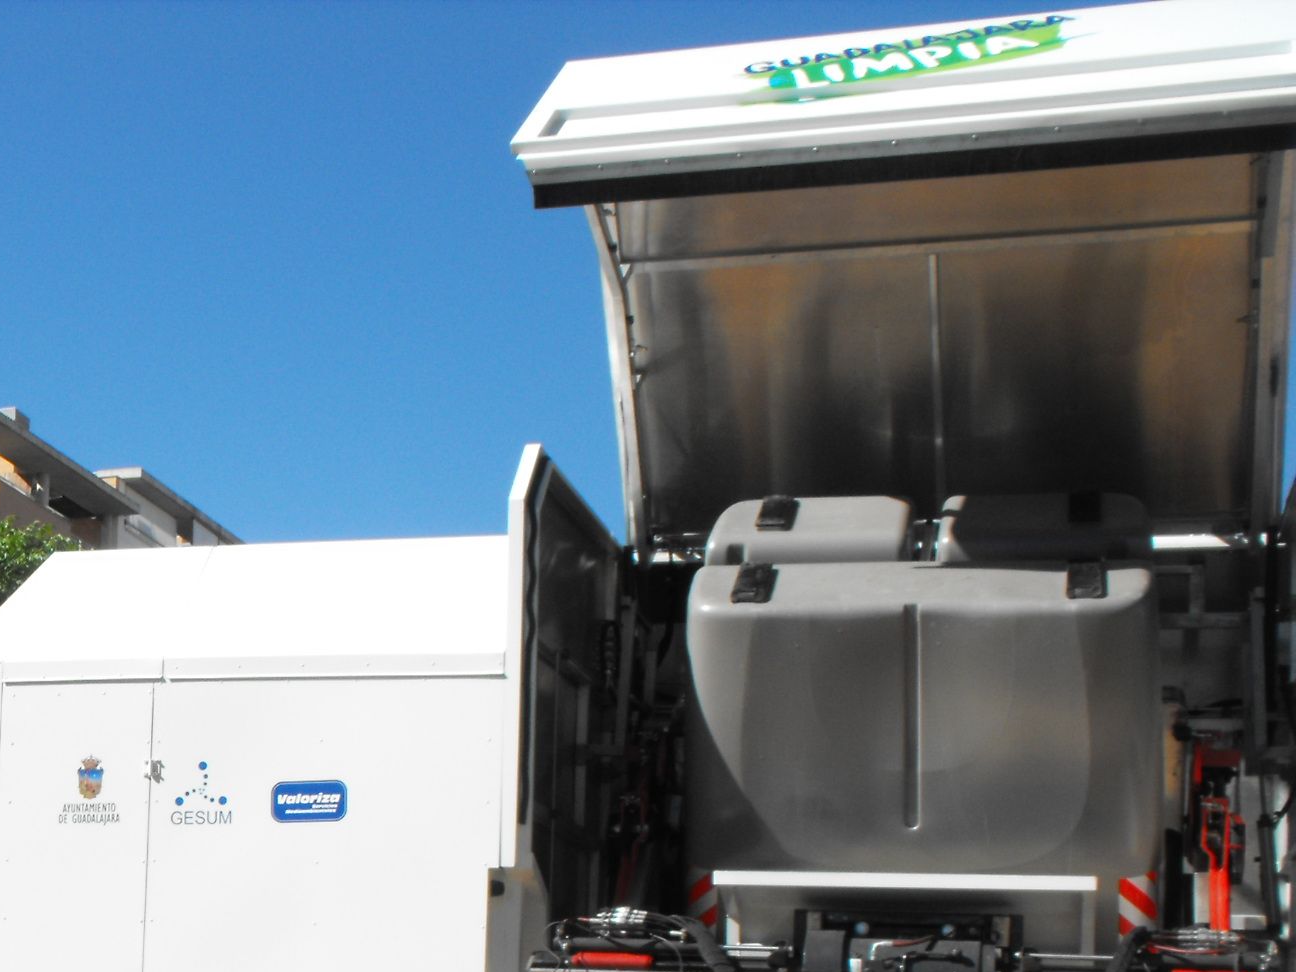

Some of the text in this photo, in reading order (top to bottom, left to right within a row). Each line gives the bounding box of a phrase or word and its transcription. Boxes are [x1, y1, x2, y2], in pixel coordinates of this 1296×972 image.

[743, 14, 1075, 75] GUADALAJARA
[791, 35, 1040, 89] LIMPIA
[277, 792, 341, 804] Valoriza
[62, 802, 116, 813] AYUNTAMIENTO
[58, 813, 120, 826] DE GUADALAJARA
[170, 810, 232, 825] GESUM
